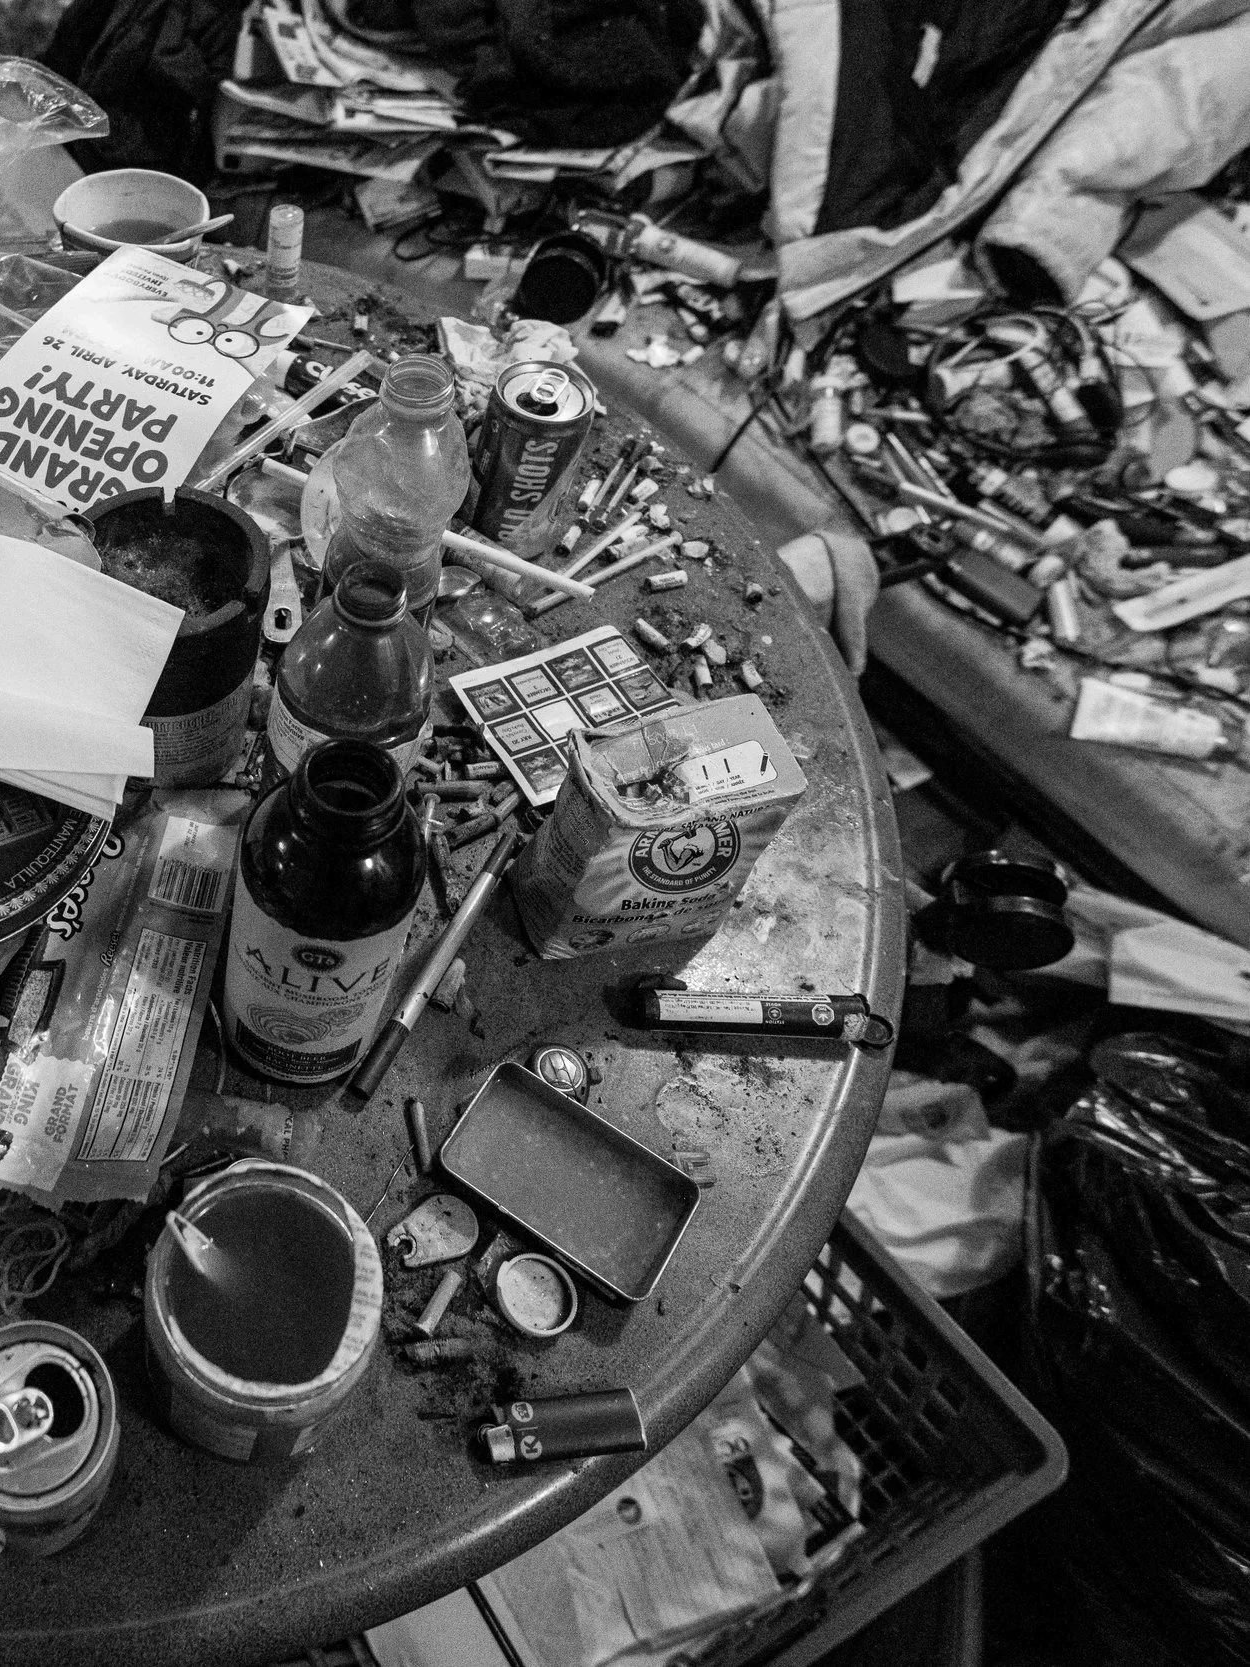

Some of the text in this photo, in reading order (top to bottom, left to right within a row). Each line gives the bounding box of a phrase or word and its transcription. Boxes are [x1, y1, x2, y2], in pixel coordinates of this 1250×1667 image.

[41, 333, 65, 352] 26
[68, 343, 116, 371] APRIL
[120, 361, 212, 408] SATURDAY,
[170, 362, 216, 390] 11:00
[24, 365, 179, 443] PARTY!
[510, 439, 559, 503] SHOTS
[608, 653, 636, 671] NOVEMBER
[525, 683, 551, 700] DECEMBER
[3, 817, 77, 889] MANTEQUILLA
[649, 867, 685, 892] STANDARD
[684, 876, 694, 885] OF
[692, 865, 718, 882] PURITY
[620, 896, 677, 912] Baking
[154, 934, 165, 956] Calories
[172, 940, 193, 994] Valeur nutritive
[183, 942, 203, 995] Nutrition Facts
[241, 937, 390, 1002] ALIVE
[12, 1078, 40, 1127] KING
[43, 1085, 68, 1136] GRAND
[51, 1083, 80, 1144] FORMAT
